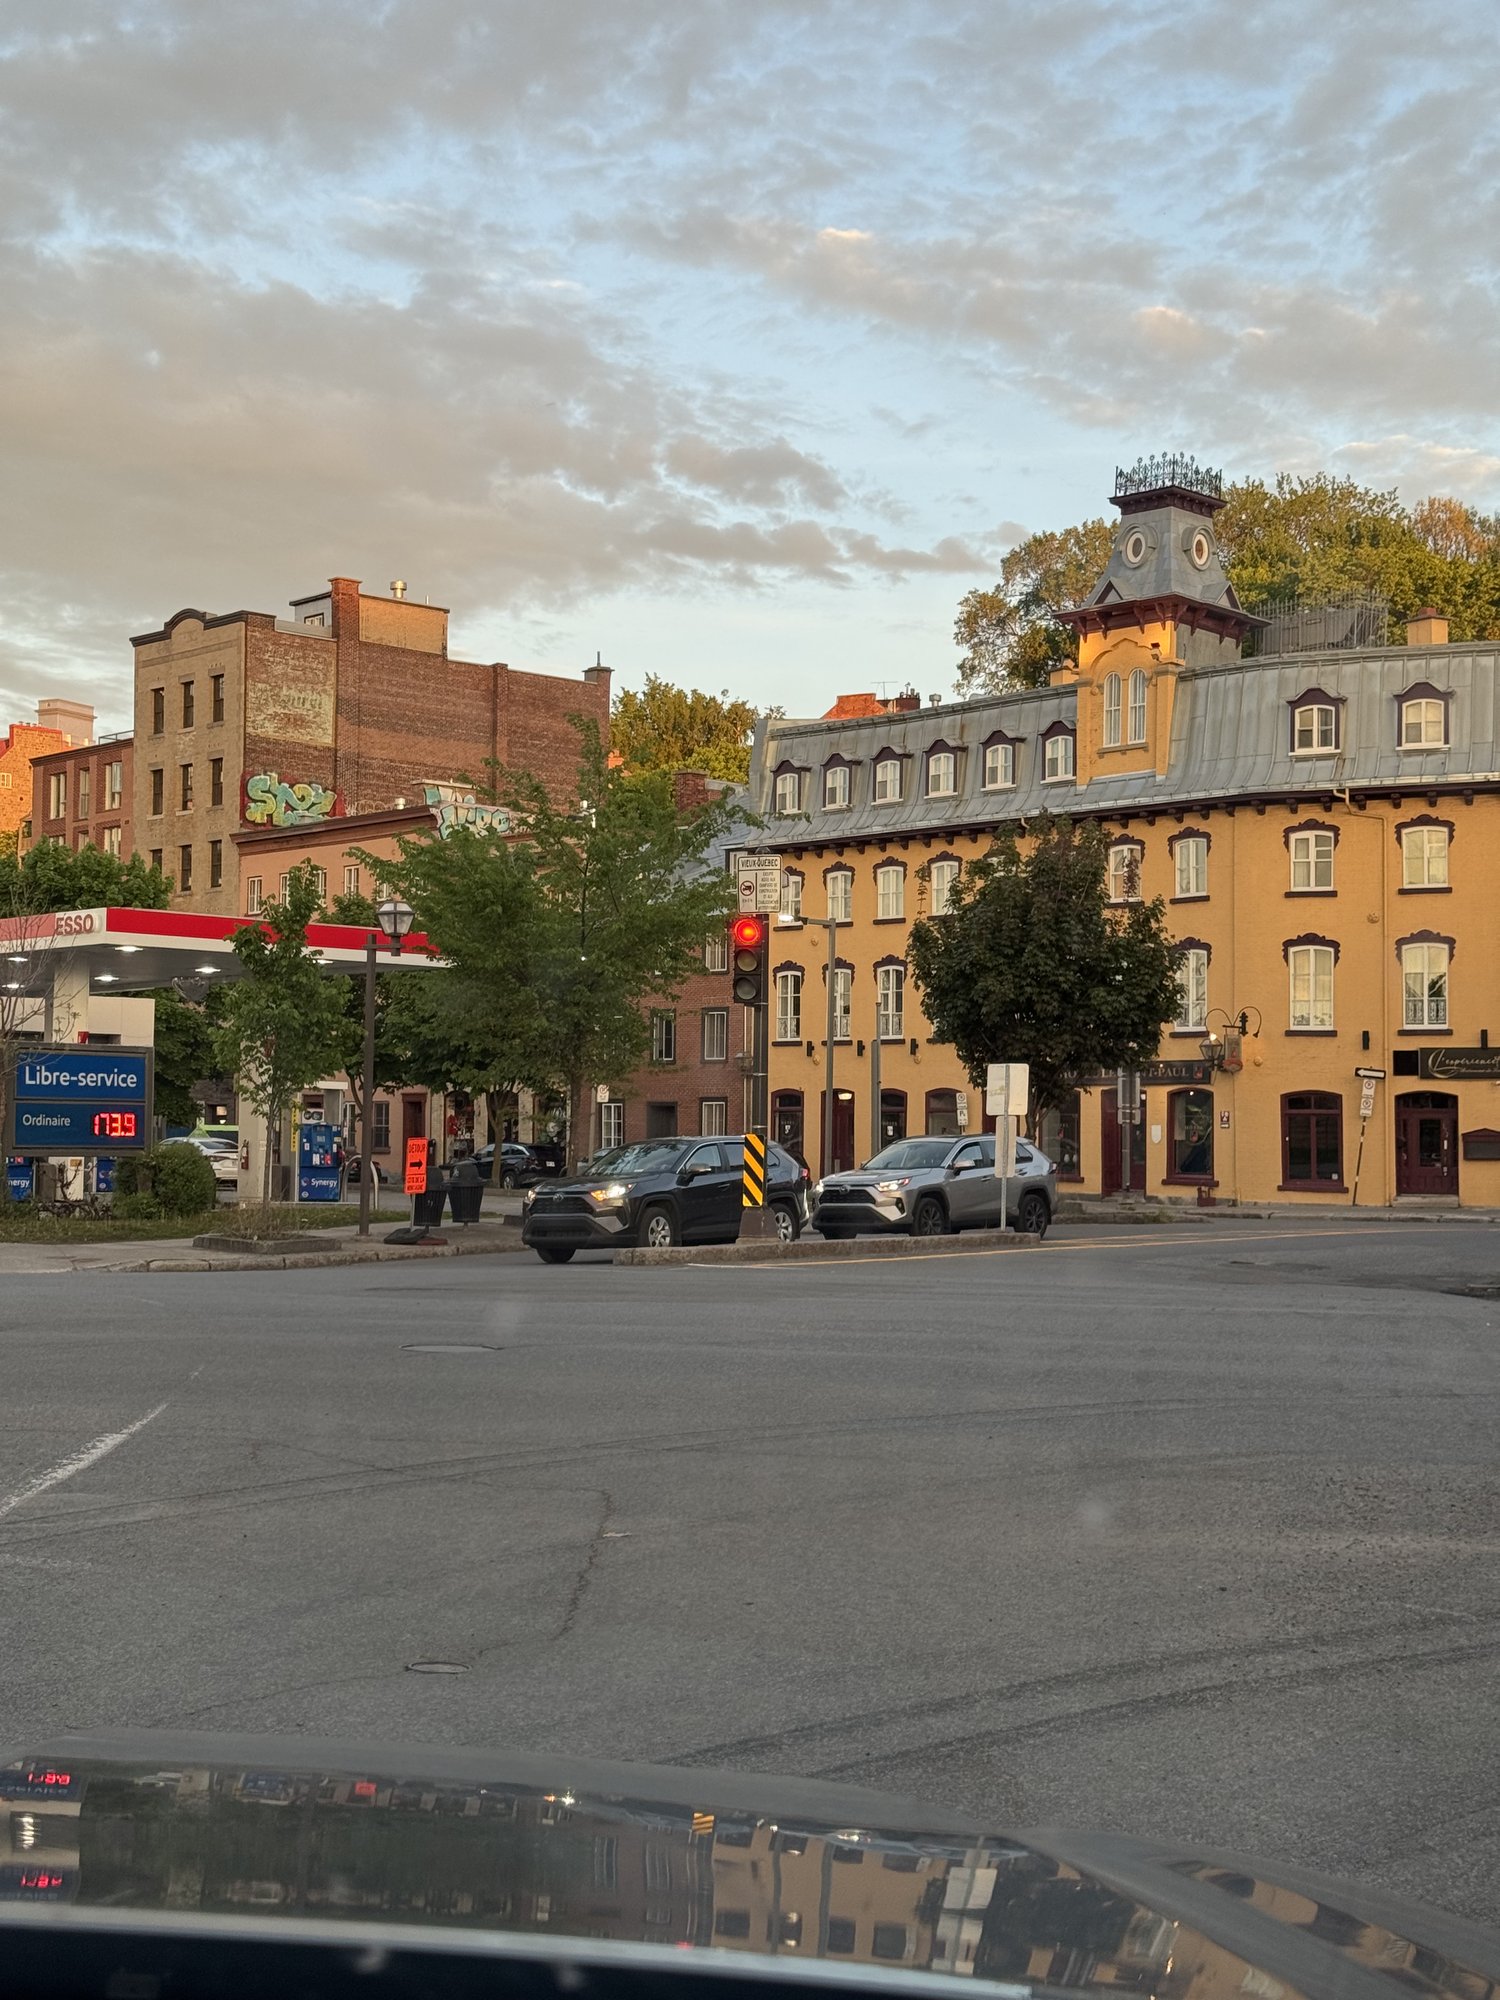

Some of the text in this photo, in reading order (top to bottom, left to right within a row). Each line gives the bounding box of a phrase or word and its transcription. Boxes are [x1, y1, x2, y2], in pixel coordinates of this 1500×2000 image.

[55, 913, 95, 936] ESSO
[25, 1065, 137, 1087] Libre-service
[22, 1112, 136, 1136] Ordinaire 173.9
[7, 1179, 30, 1188] nergy
[311, 1178, 338, 1188] Synergy
